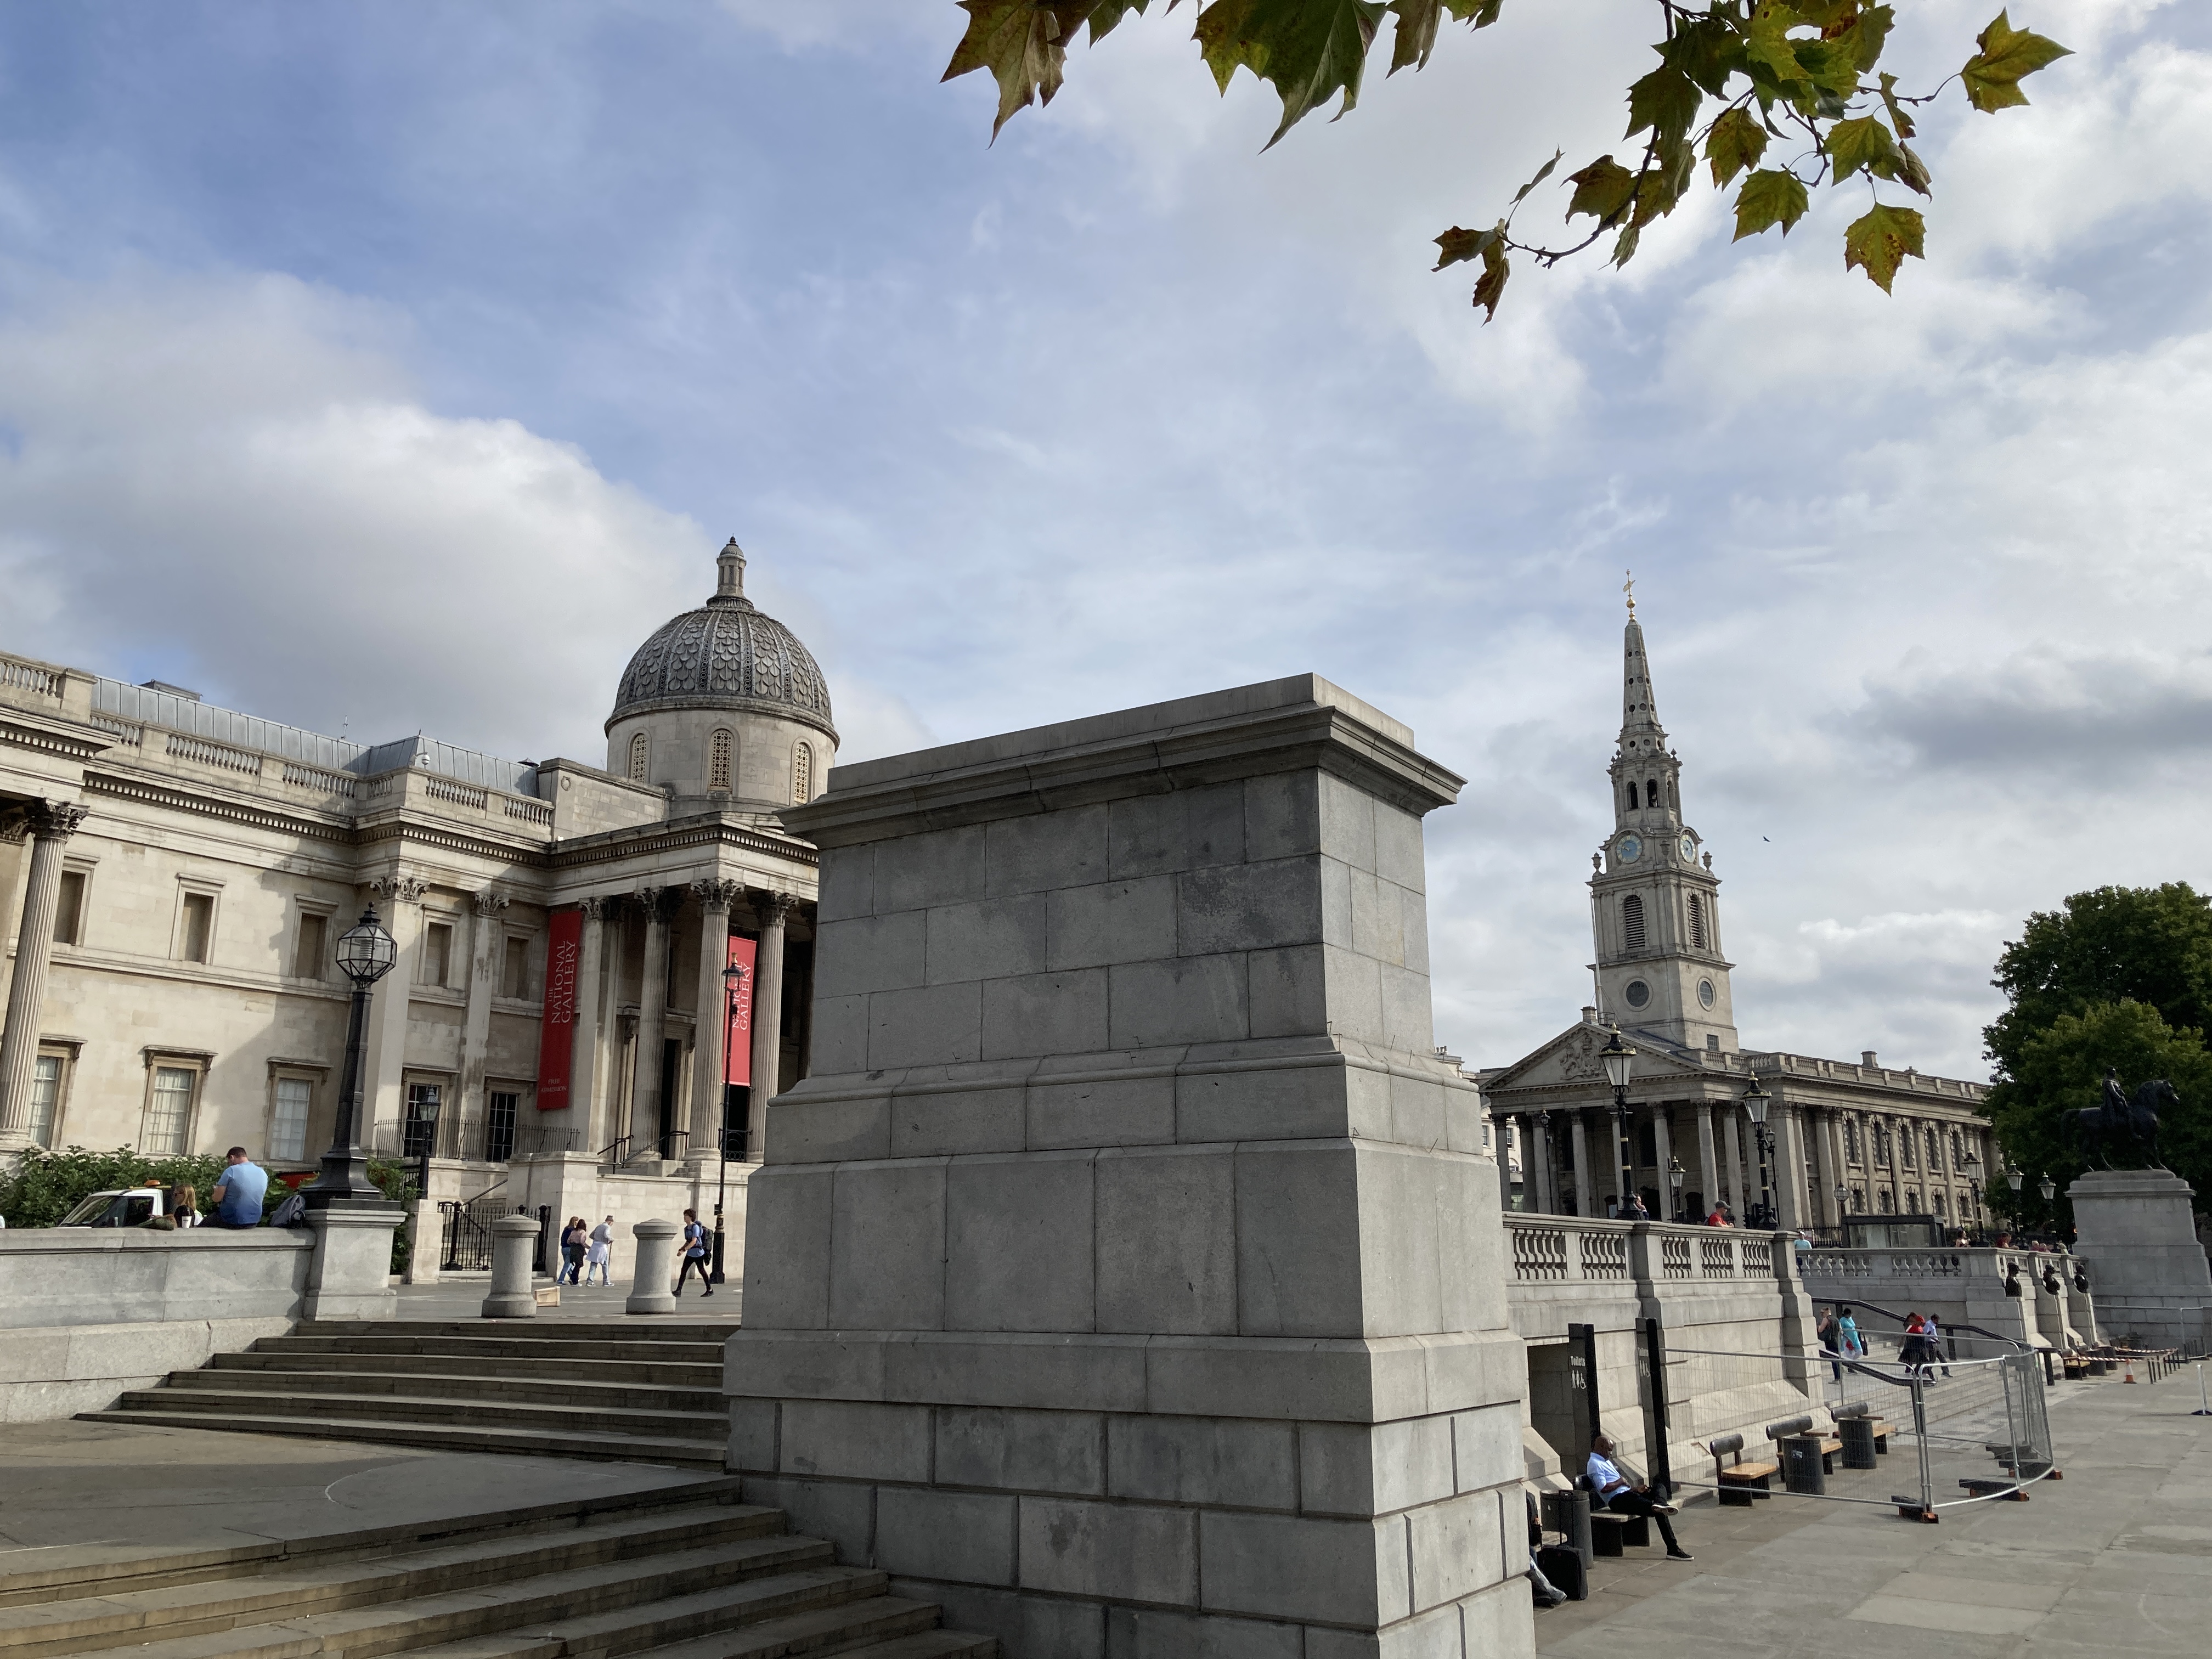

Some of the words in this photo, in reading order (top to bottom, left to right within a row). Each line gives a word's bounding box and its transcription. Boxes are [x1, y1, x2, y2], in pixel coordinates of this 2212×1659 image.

[551, 940, 566, 1023] NATIONAL
[561, 940, 576, 1023] GALLERY
[740, 962, 751, 1030] GALLERY
[1570, 1356, 1585, 1367] Toilets
